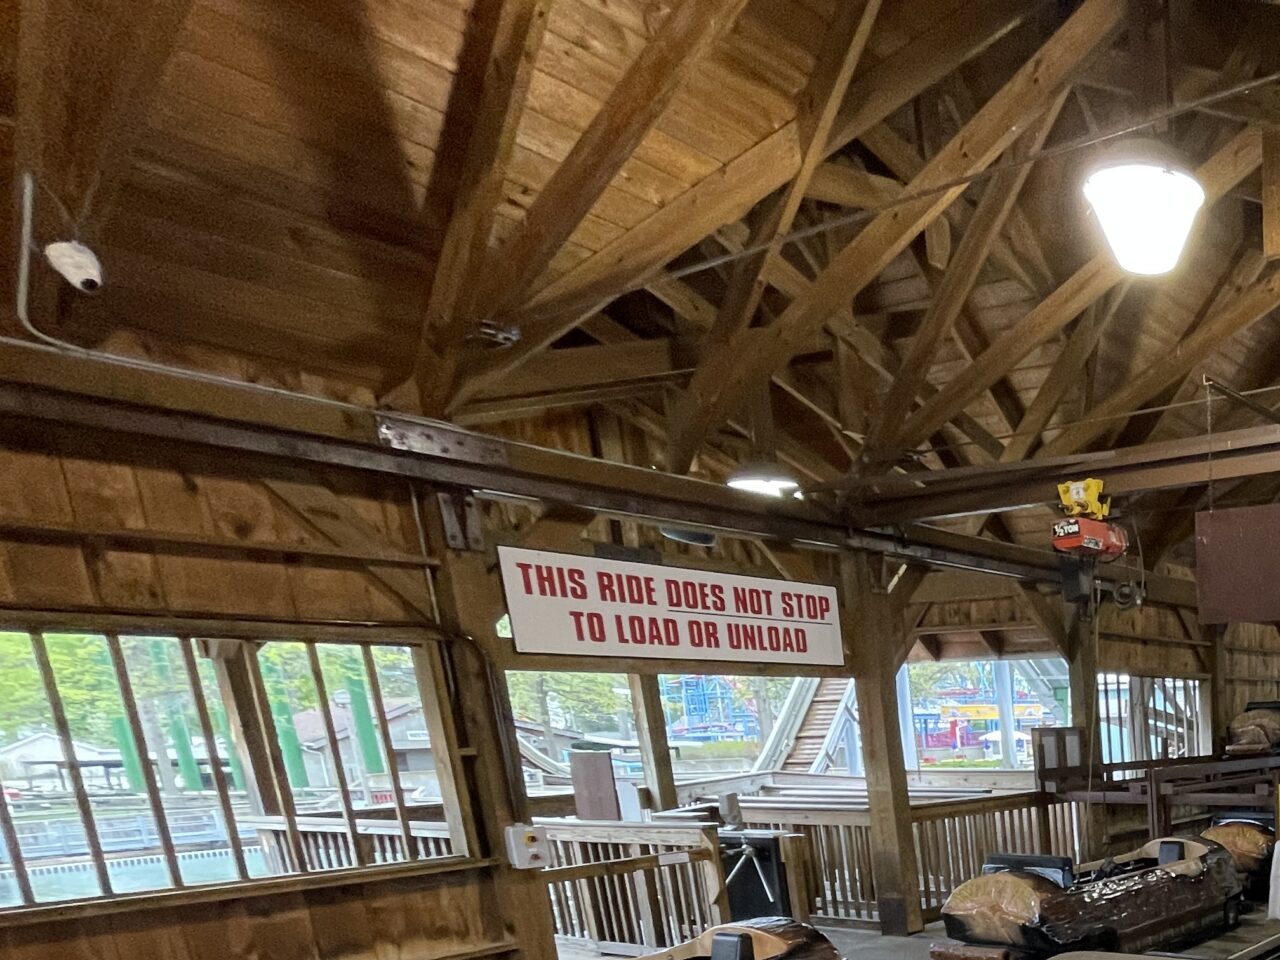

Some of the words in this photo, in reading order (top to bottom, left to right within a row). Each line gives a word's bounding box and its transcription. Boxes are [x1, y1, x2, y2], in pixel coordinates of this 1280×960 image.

[516, 562, 588, 600] THIS
[596, 571, 657, 606] RIDE
[665, 579, 726, 612] DOES
[733, 587, 773, 616] NOT
[781, 591, 831, 621] STOP
[569, 610, 606, 643] TO
[615, 614, 680, 646] LOAD
[688, 620, 720, 649] OR
[727, 622, 808, 653] UNLOAD
